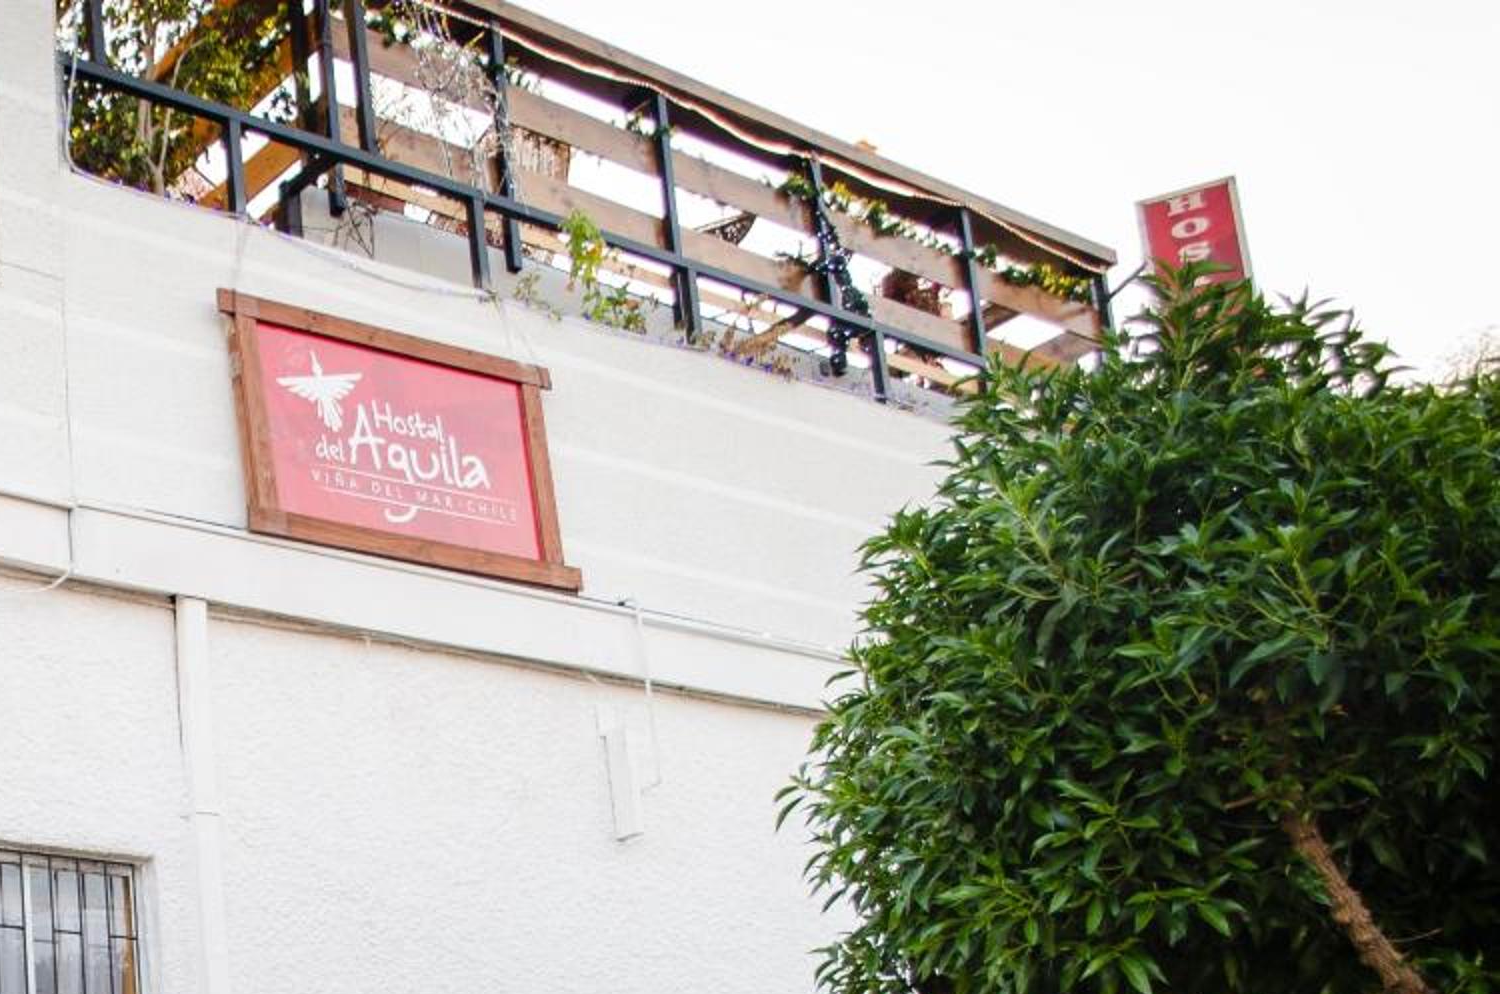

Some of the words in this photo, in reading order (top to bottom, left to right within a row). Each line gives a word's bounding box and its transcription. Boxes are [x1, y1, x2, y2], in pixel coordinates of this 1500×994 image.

[1166, 191, 1213, 288] HOS
[371, 400, 445, 443] Hostal
[315, 434, 345, 463] del
